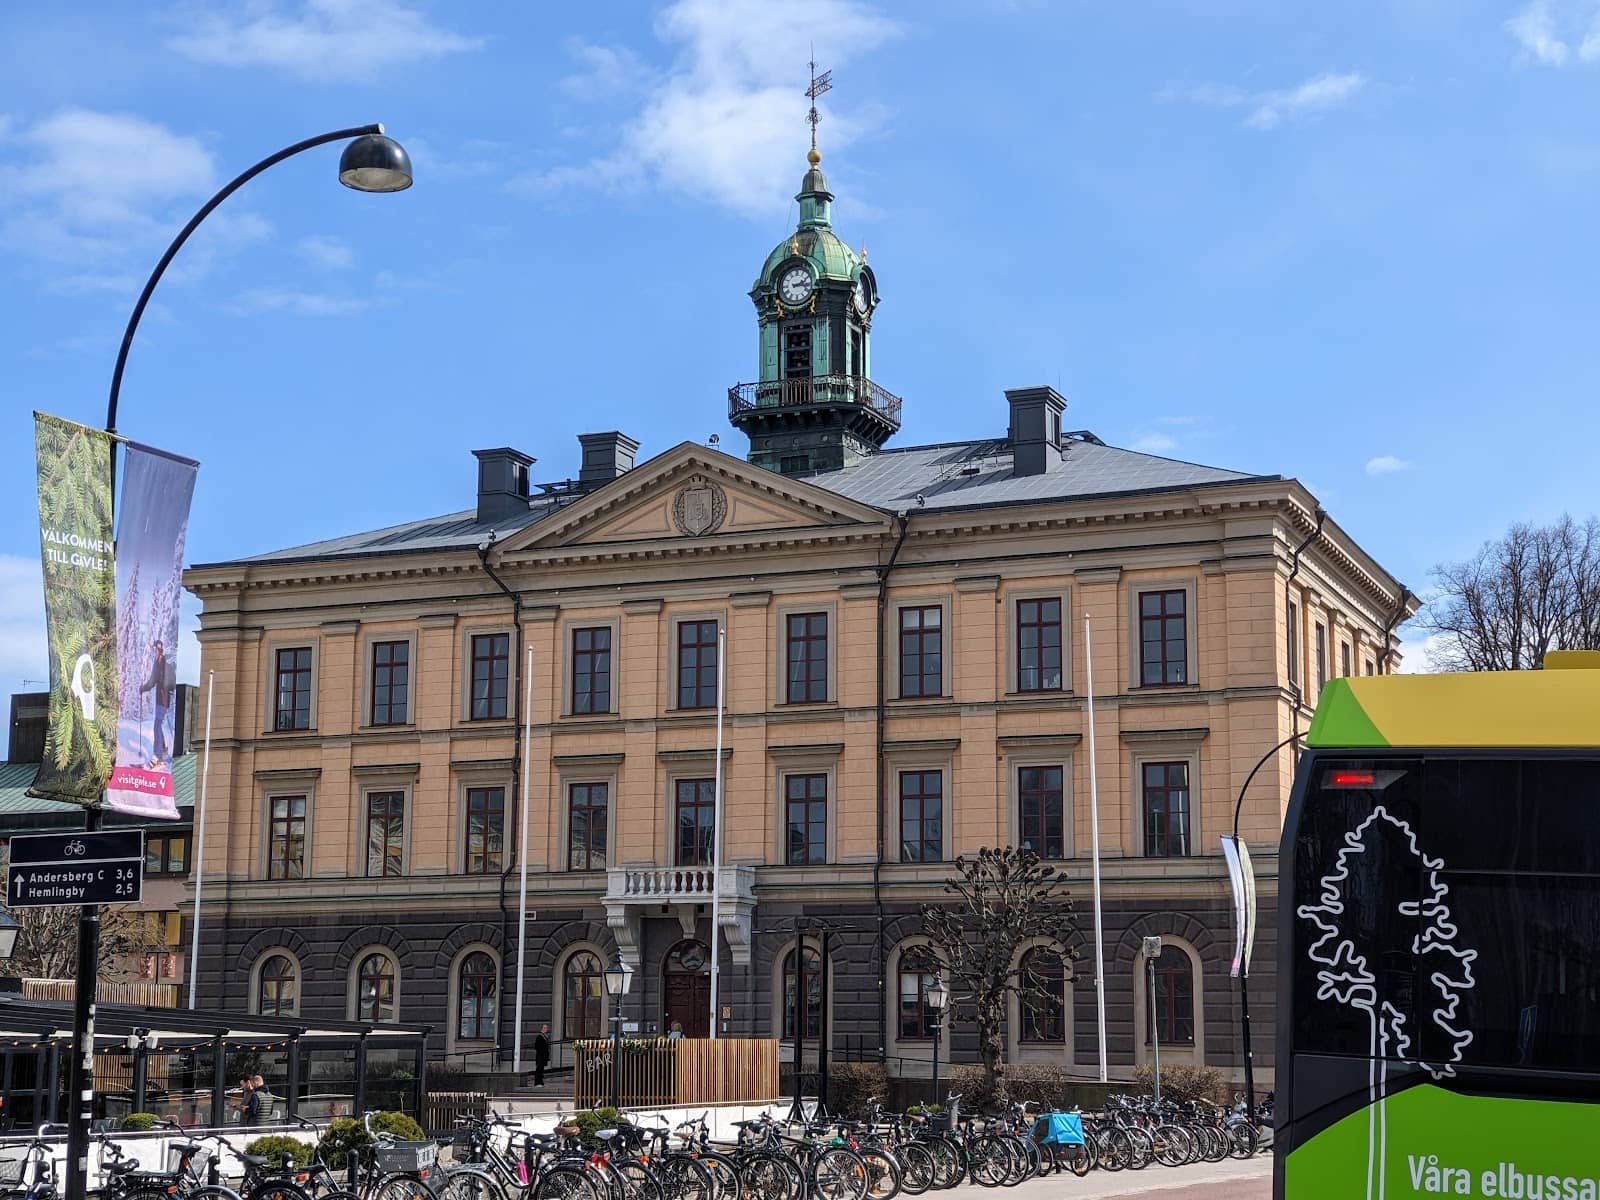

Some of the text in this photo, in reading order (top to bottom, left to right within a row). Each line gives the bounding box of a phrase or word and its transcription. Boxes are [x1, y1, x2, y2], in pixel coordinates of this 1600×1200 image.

[42, 527, 114, 554] VÄLKOMMEN
[47, 548, 69, 564] TILL
[29, 868, 134, 883] Andersberg C 3,6
[28, 883, 133, 898] Hemlingby 2,5
[586, 1053, 613, 1073] BAR
[1407, 1154, 1600, 1200] Våra elbussa
